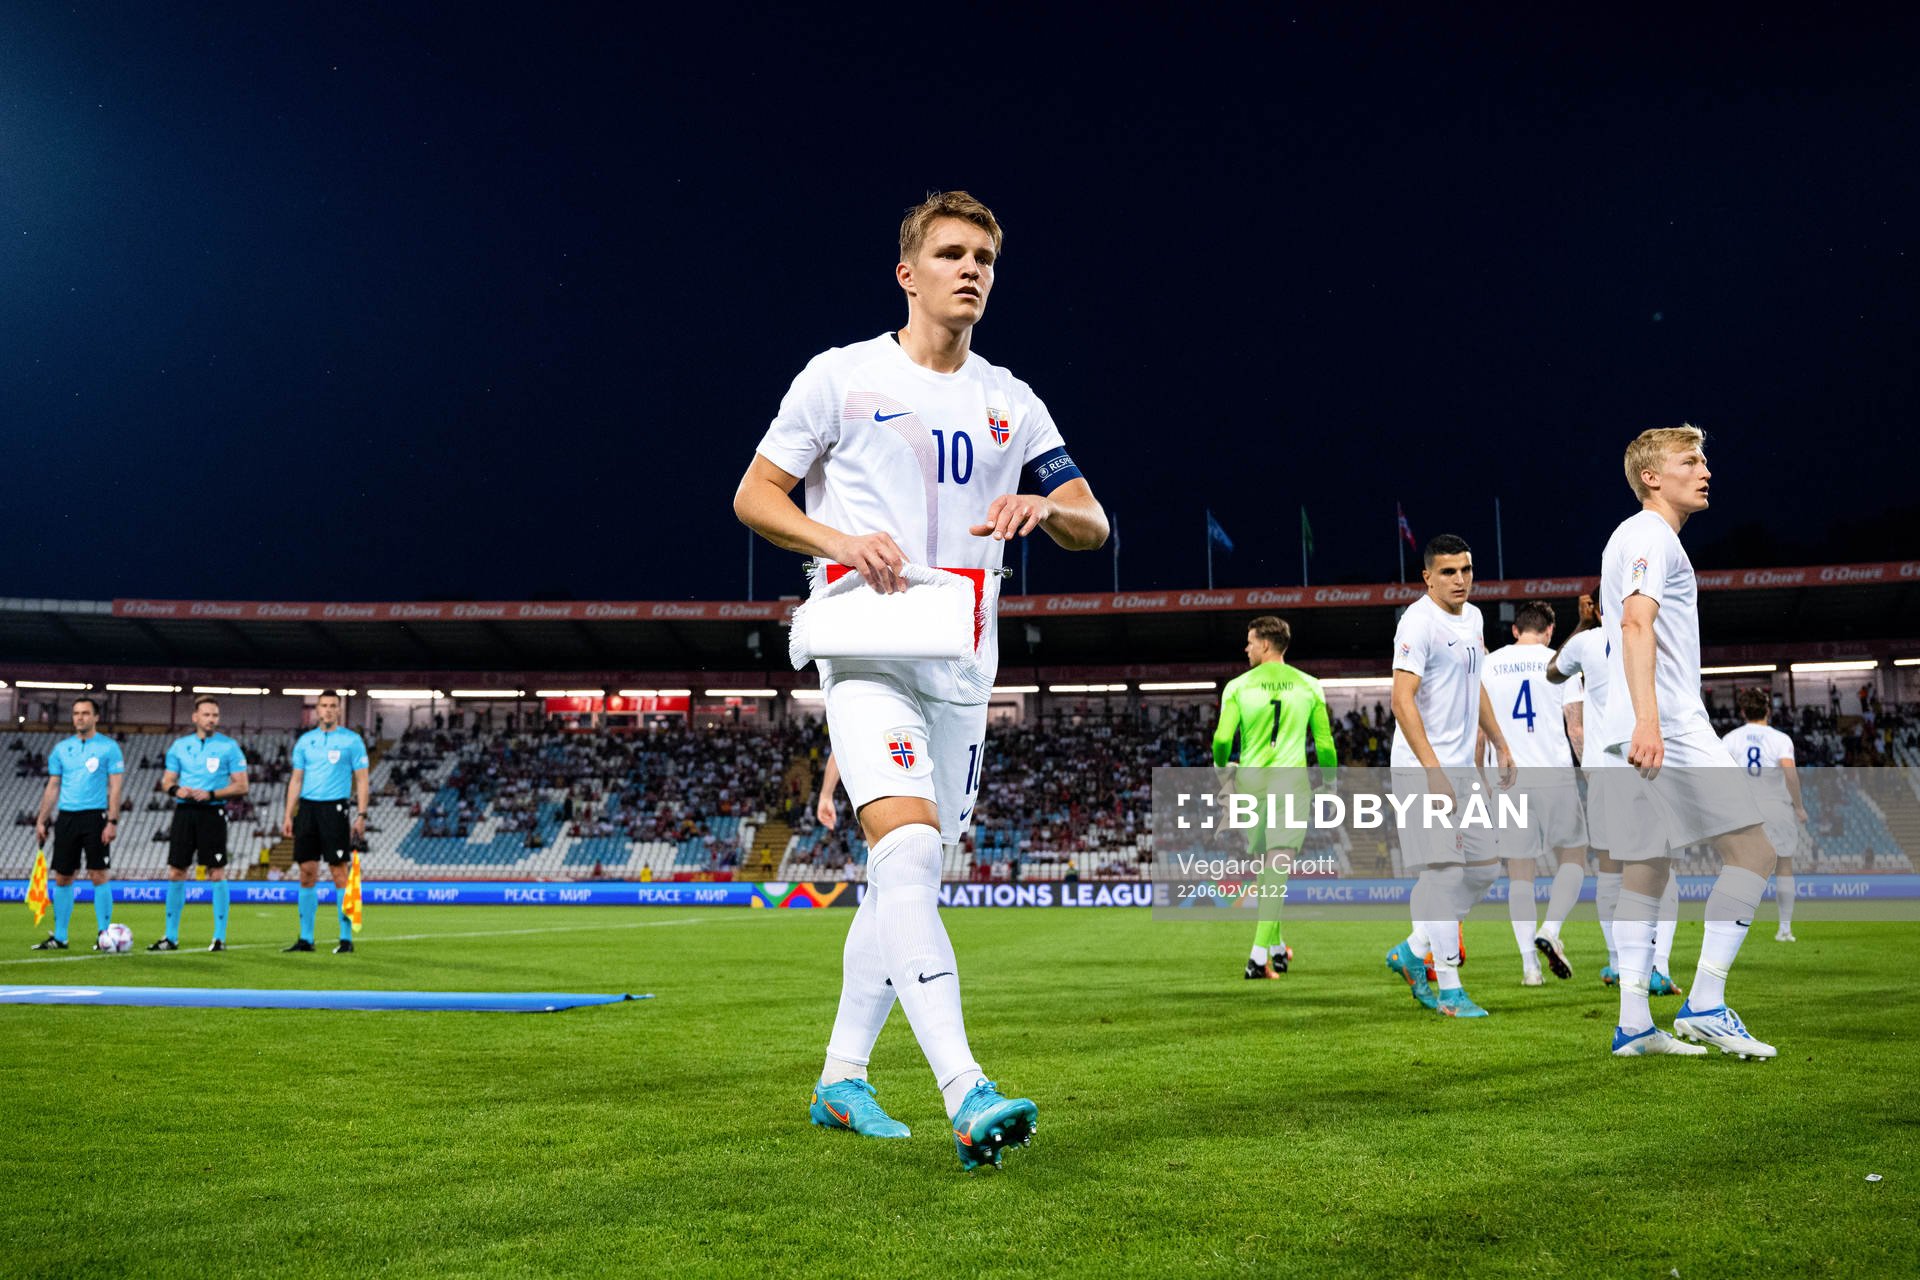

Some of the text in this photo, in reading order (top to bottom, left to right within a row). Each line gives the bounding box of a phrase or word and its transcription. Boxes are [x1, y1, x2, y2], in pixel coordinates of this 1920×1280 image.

[932, 429, 974, 485] 10
[1466, 647, 1476, 673] 11
[1261, 681, 1294, 691] NYLAND
[1512, 680, 1536, 732] 4
[1270, 700, 1281, 747] 1
[1747, 746, 1761, 777] 8
[123, 887, 161, 899] PEACE
[247, 888, 286, 900] PEACE
[374, 889, 414, 901] PEACE
[504, 889, 545, 901] PEACE
[639, 889, 680, 902] PEACE
[938, 885, 1168, 906] NATIONS LEAGUE
[1307, 887, 1353, 900] PEACE
